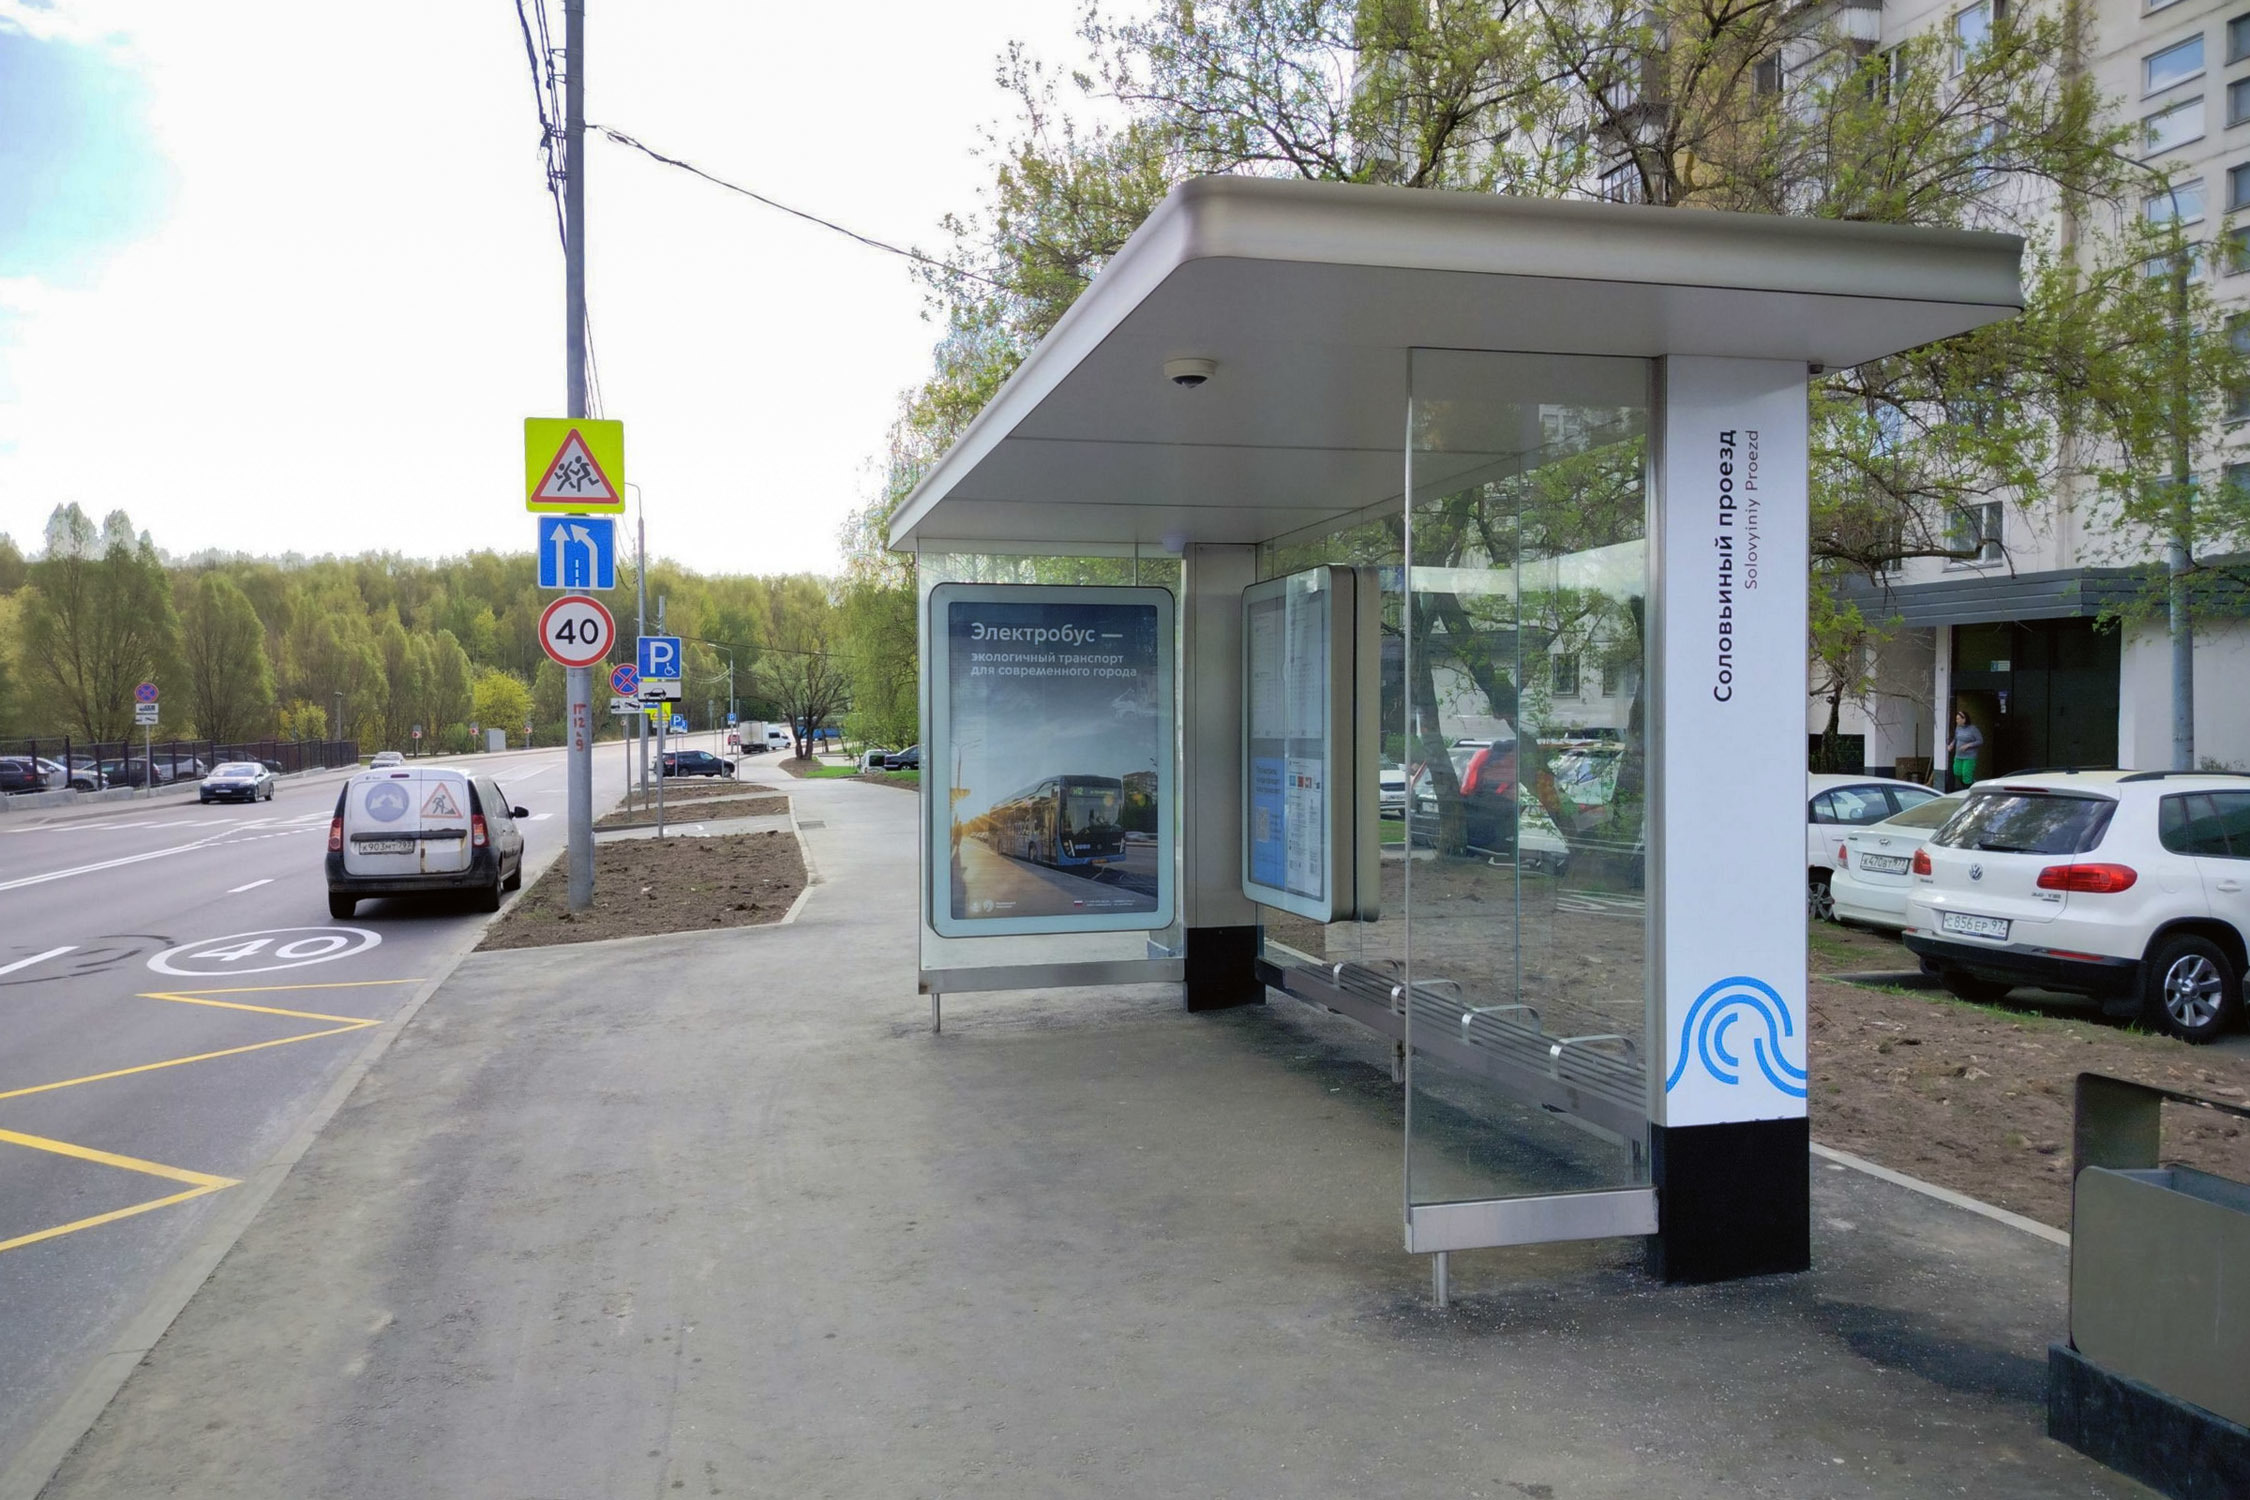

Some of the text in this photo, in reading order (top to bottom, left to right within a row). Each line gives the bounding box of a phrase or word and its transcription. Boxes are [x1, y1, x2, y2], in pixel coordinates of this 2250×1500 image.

[1744, 430, 1761, 589] Solovyiniy Proezd
[1713, 429, 1737, 703] Соловьиный проезд
[555, 618, 599, 645] 40
[970, 622, 1096, 646] Электробус
[650, 641, 674, 674] P
[970, 652, 1124, 666] экологичный транспорт
[970, 666, 1137, 678] для современного города
[188, 936, 348, 962] 40
